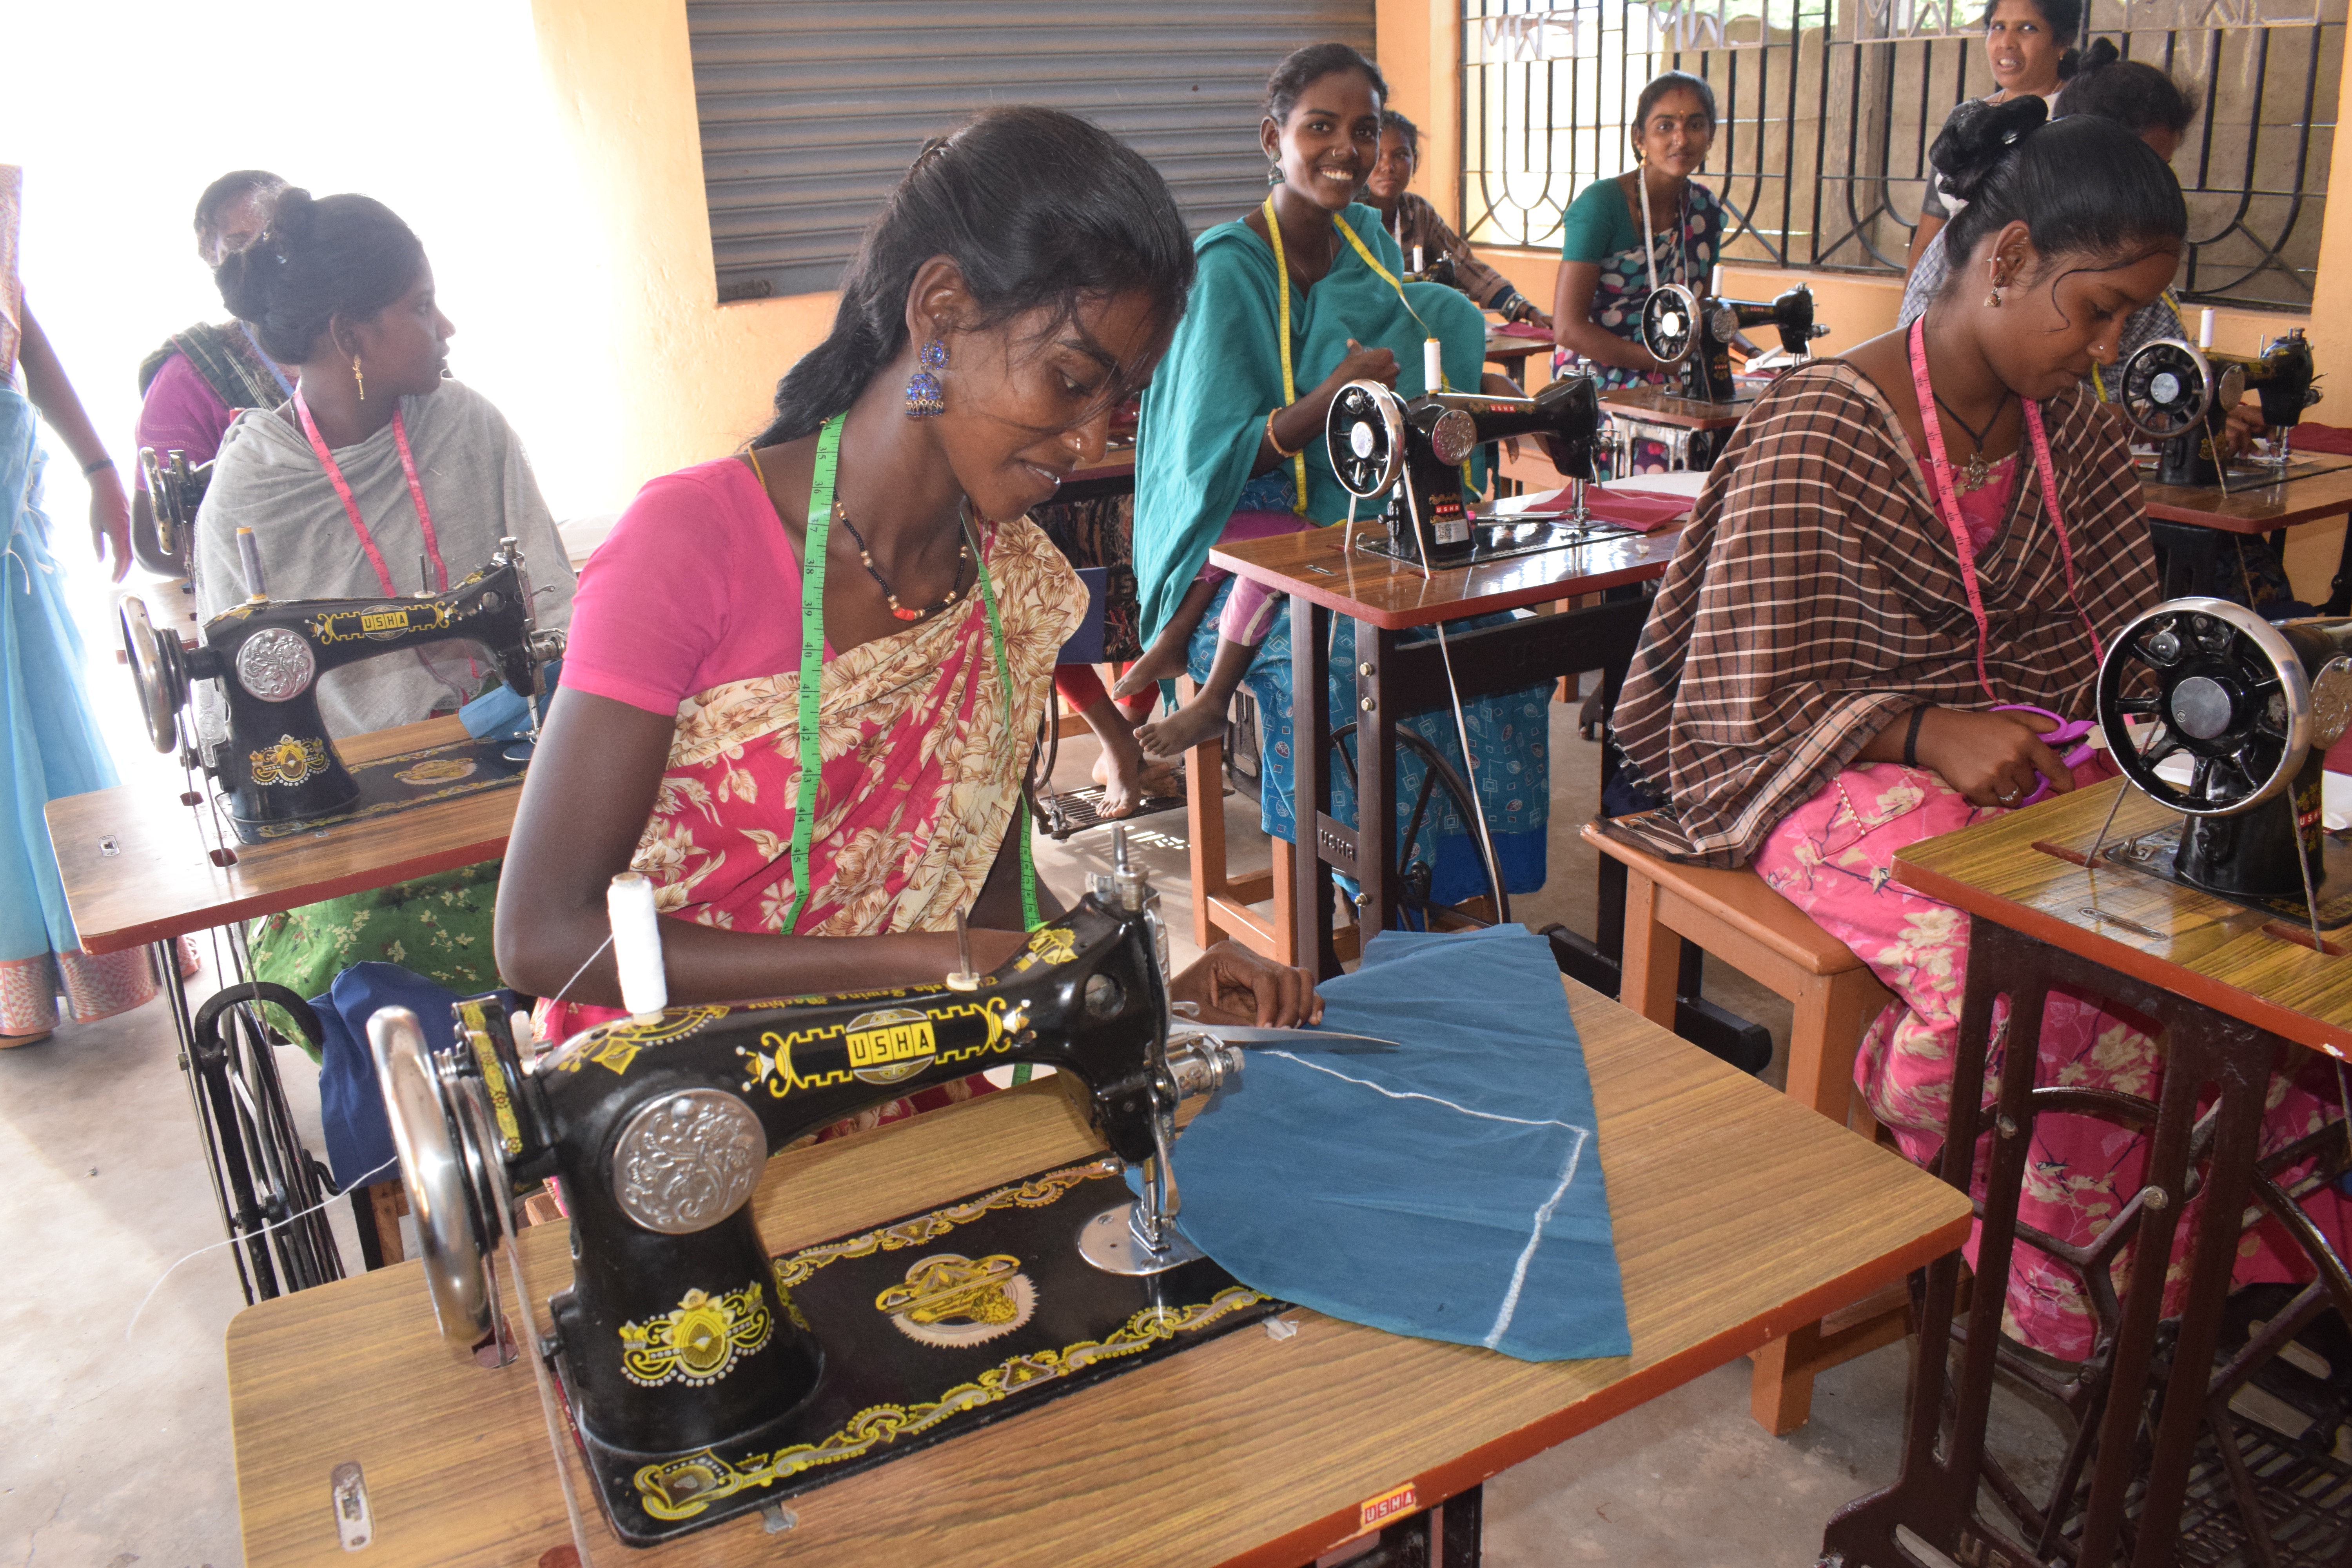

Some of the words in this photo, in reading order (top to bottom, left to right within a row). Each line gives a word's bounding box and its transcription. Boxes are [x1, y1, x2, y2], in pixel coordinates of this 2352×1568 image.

[818, 446, 827, 459] 35
[813, 481, 824, 494] 36
[809, 517, 819, 534] 37
[806, 558, 815, 575] 38
[804, 600, 813, 617] 39
[364, 614, 405, 628] USHA
[804, 641, 813, 658] 40
[802, 683, 811, 699] 41
[802, 726, 810, 742] 42
[804, 767, 813, 783] 43
[797, 807, 806, 822] 44
[794, 847, 801, 863] 45
[796, 888, 804, 904] 46
[748, 995, 829, 1009] Machine
[853, 1029, 929, 1059] USHA
[1367, 1491, 1413, 1521] USHA
